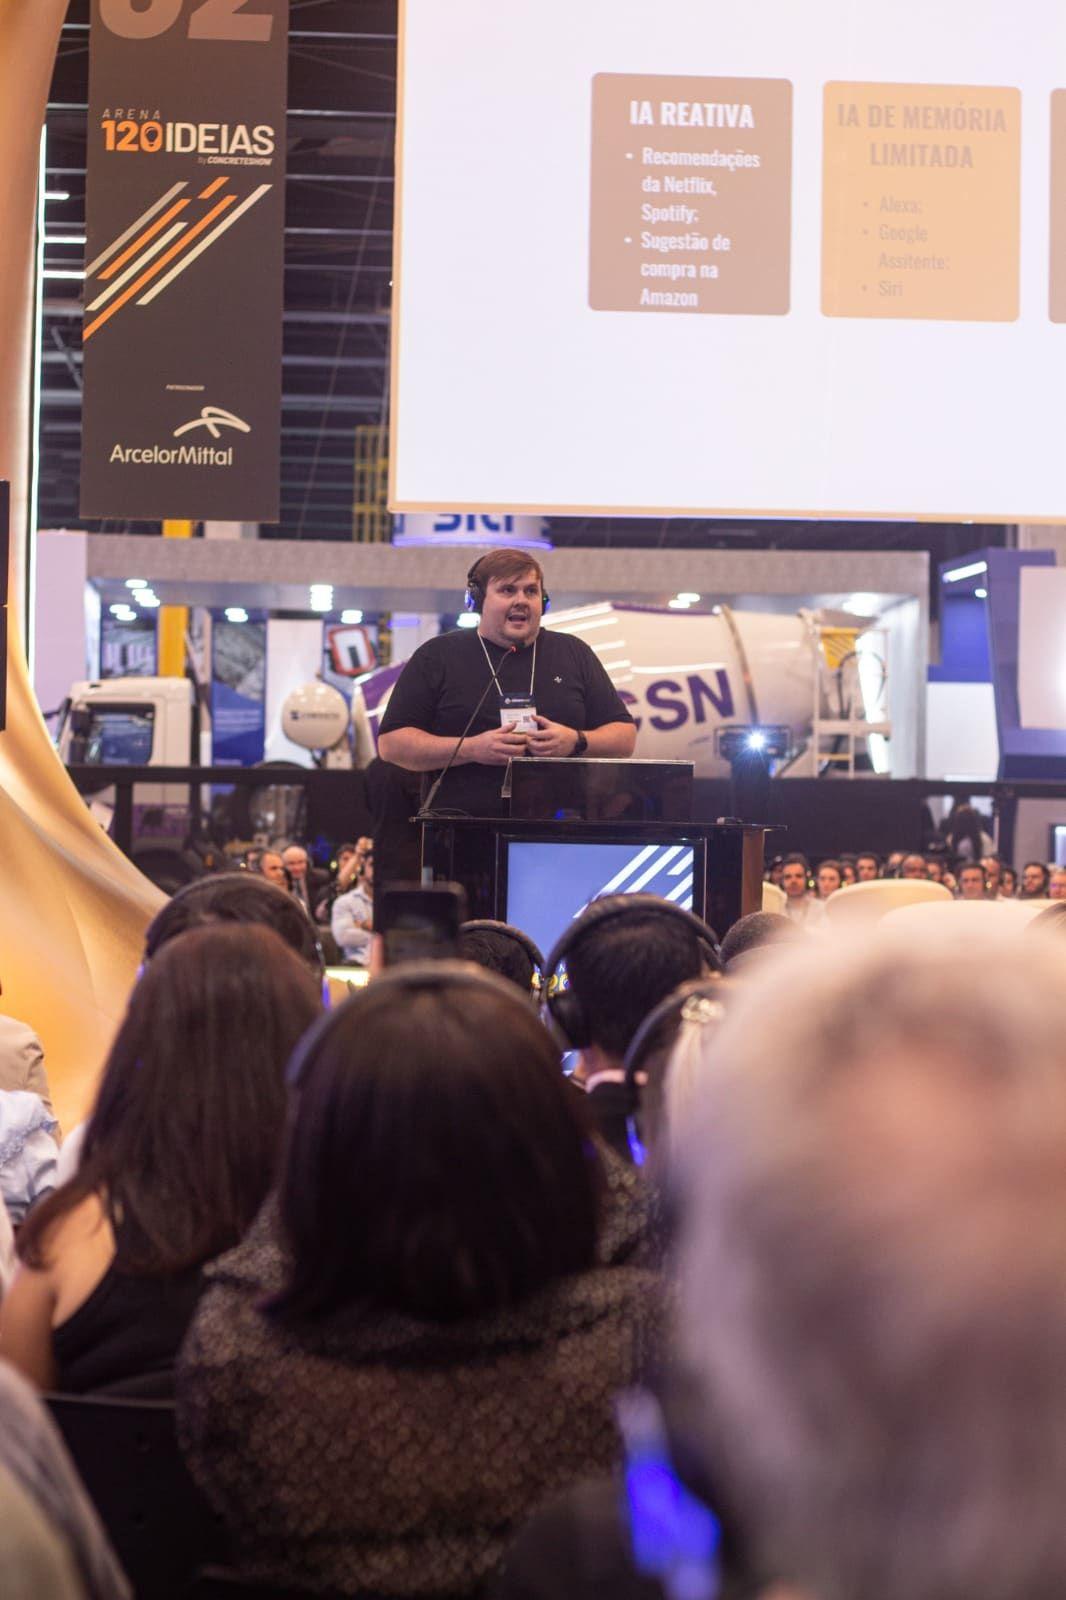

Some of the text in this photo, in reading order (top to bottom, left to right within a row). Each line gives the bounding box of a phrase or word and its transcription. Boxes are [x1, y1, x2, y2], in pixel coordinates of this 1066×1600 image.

[102, 108, 161, 120] ARENA
[630, 100, 755, 128] IA REATIVA
[836, 100, 1008, 133] IA DE MEMÓRIA
[642, 147, 760, 171] Recomendações
[869, 143, 975, 168] LIMITADA
[642, 176, 660, 193] da
[641, 231, 730, 253] Sugestão de
[879, 224, 928, 244] Google
[640, 262, 718, 280] compra na
[640, 288, 698, 306] Amazon
[878, 280, 904, 297] Siri
[110, 444, 233, 466] ArcelorMittal
